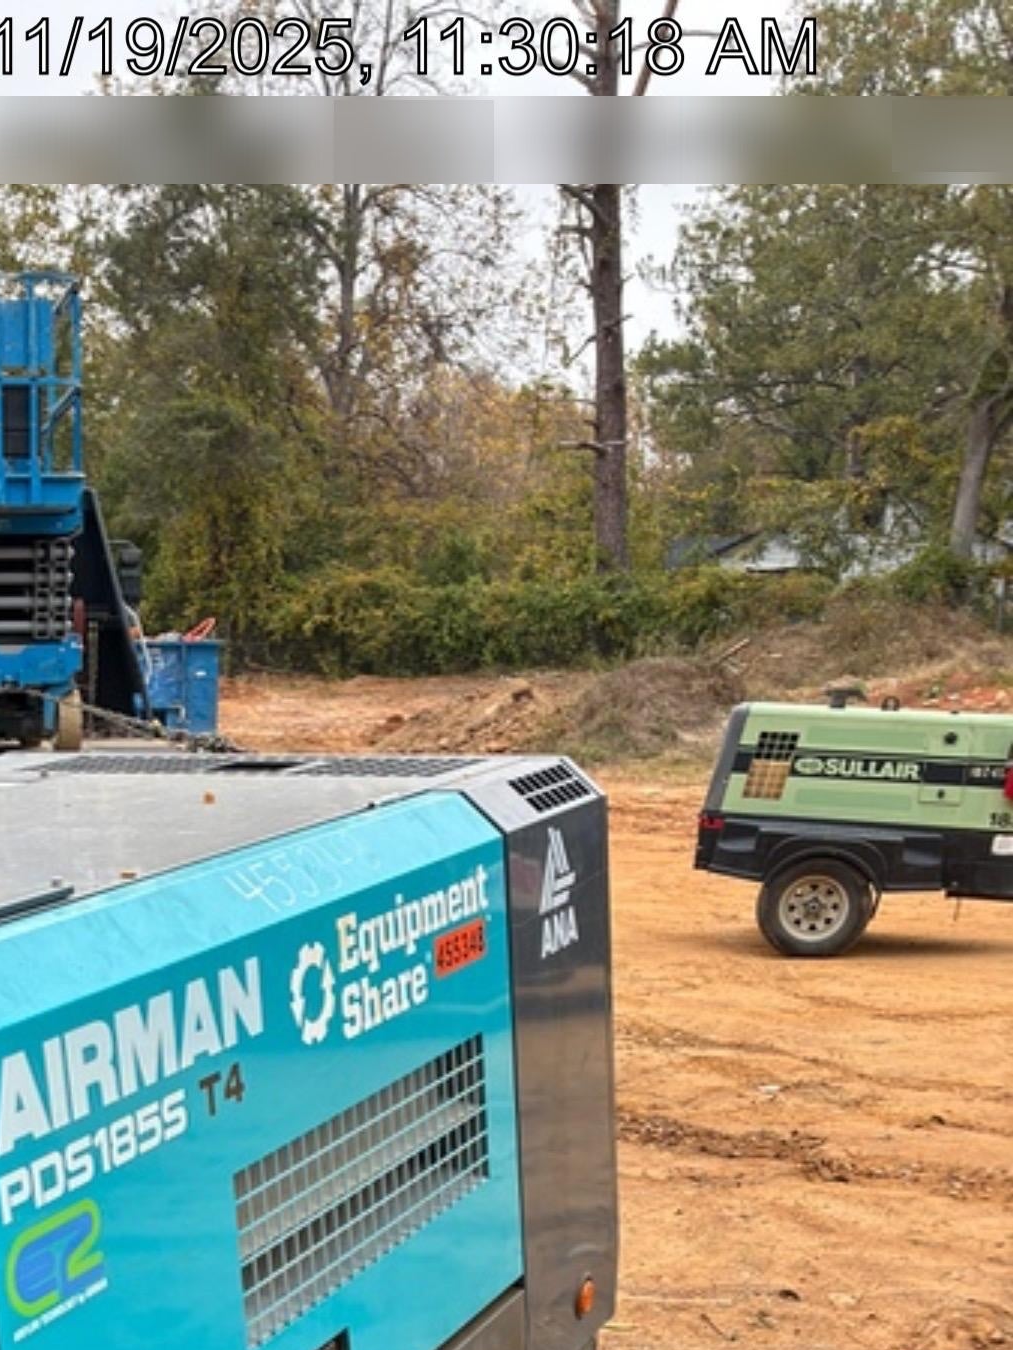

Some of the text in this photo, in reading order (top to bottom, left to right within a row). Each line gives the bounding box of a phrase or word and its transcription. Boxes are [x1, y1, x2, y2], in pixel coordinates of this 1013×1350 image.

[824, 758, 920, 780] SULLAIR
[337, 864, 488, 973] Equipment
[541, 905, 579, 959] ANA
[341, 963, 429, 1040] Share
[199, 1062, 245, 1116] T4
